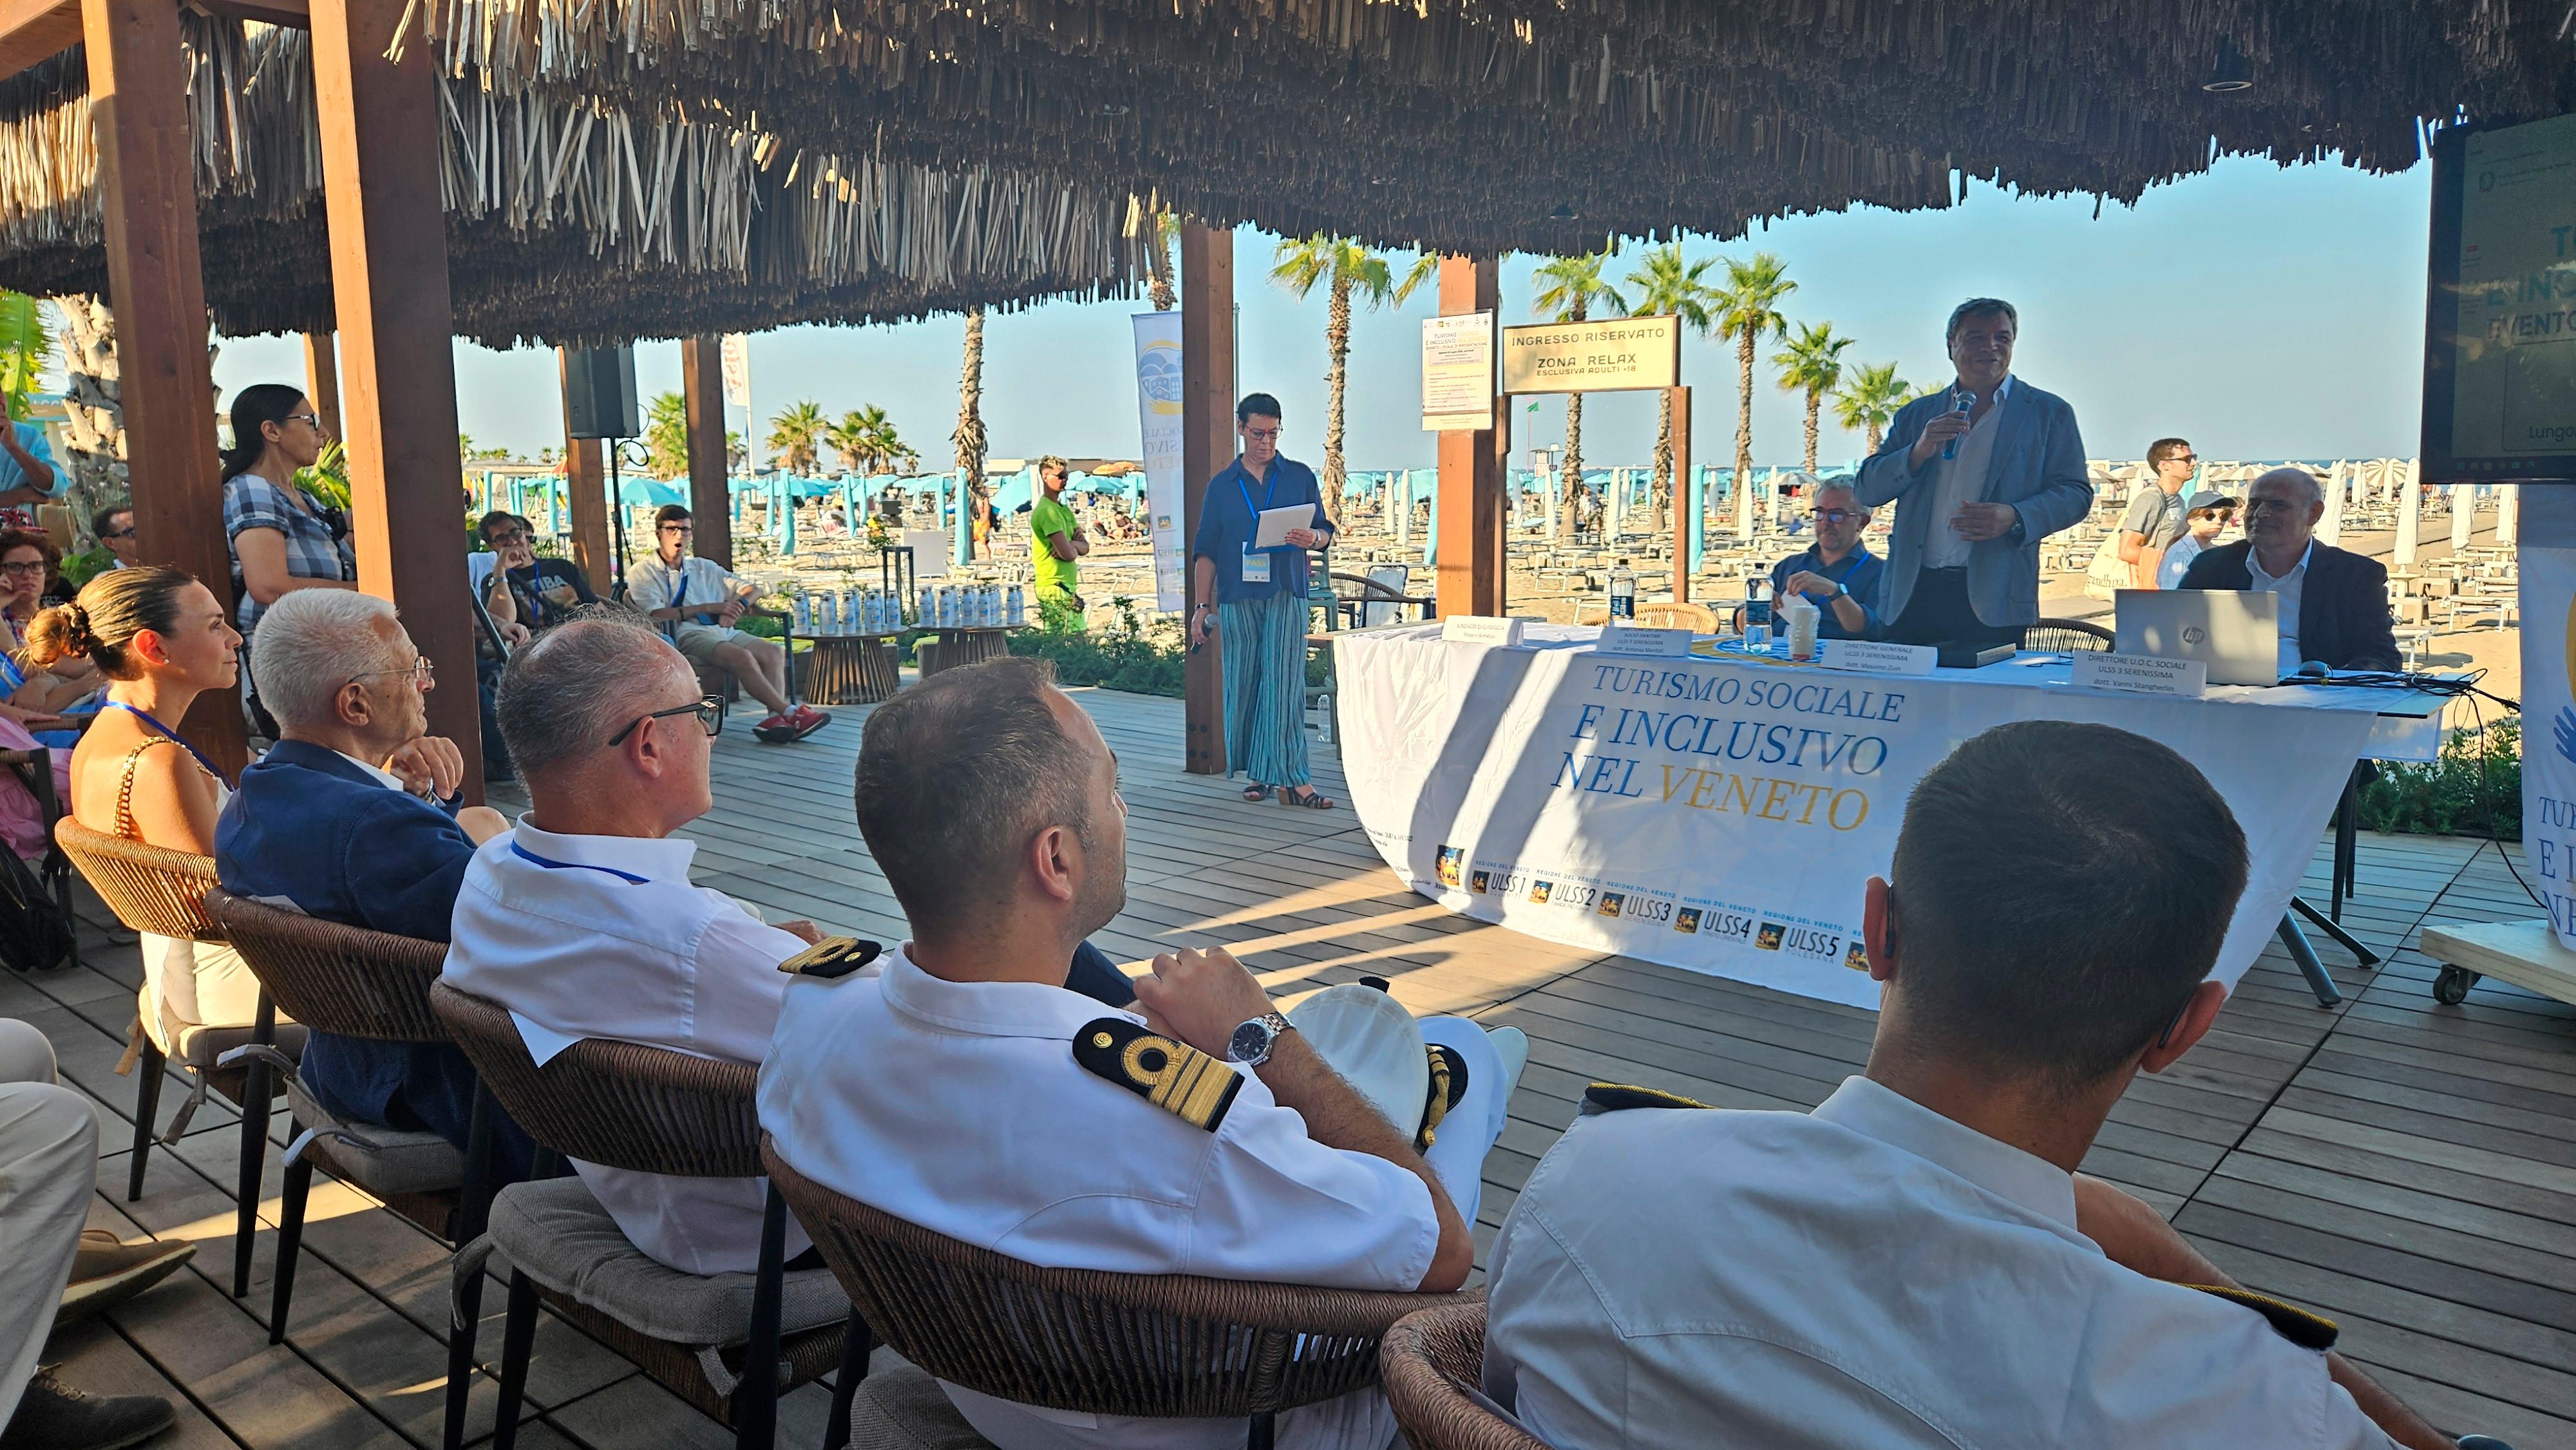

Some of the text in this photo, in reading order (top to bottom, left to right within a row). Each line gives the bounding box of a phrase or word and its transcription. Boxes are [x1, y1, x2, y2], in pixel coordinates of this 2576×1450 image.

[2551, 225, 2576, 257] T
[1512, 328, 1665, 346] INGRESSO RISERVATO
[1538, 353, 1636, 368] ZONA RELAX
[1537, 368, 1585, 376] ESCLUSIVA
[2530, 426, 2576, 442] Lungo
[2184, 627, 2204, 645] hp
[1844, 643, 1878, 651] DIRETTORE
[1865, 652, 1908, 662] SERENISSIMA
[2088, 654, 2128, 665] DIRETTORE
[2155, 661, 2187, 670] SOCIALE
[2098, 666, 2116, 674] ULSS
[2124, 668, 2174, 679] SERENISSIMA
[1593, 665, 1905, 722] TURISMO SOCIALE
[2094, 677, 2175, 692] dott. Vanni Stangherlin
[1570, 703, 1888, 775] E INCLUSIVO
[1550, 751, 1868, 831] NEL VENETO
[2538, 838, 2556, 879] E
[1492, 873, 1517, 892] ULSS
[1537, 869, 1600, 885] REGIONE DEL VENETO
[1607, 881, 1634, 890] REGIONE
[1651, 889, 1676, 899] VENETO
[1627, 895, 1671, 921] ULSS3
[1683, 896, 1757, 914] REGIONE DEL VENETO
[1624, 915, 1666, 928] SERENISSIMA
[1704, 910, 1752, 939] ULSS4
[1763, 910, 1843, 932] REGIONE DEL VENETO
[1788, 927, 1840, 957] ULSS5
[1785, 946, 1835, 965] POLESANA
